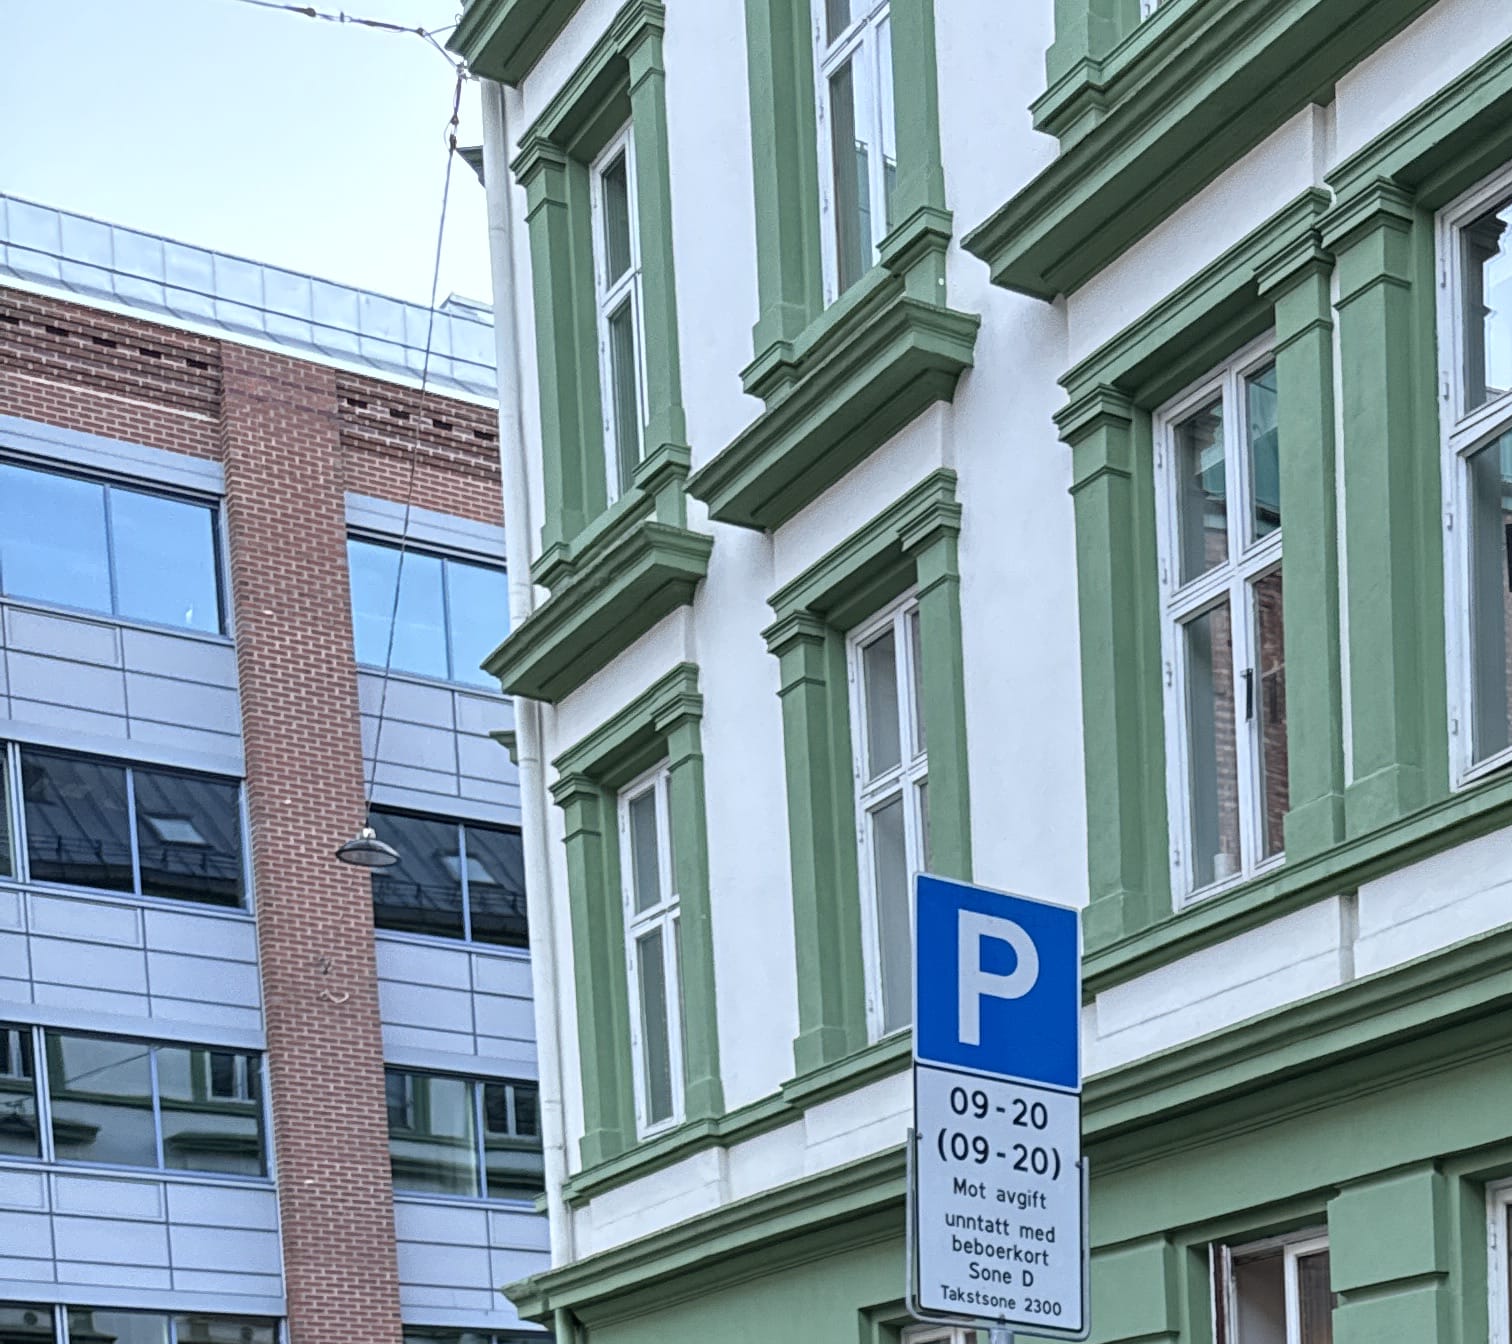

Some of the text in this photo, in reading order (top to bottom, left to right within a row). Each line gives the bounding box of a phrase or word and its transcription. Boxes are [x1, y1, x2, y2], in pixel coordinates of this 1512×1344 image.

[957, 908, 1040, 1047] P
[953, 1177, 1047, 1211] Mot avgift
[945, 1212, 1055, 1243] unntatt med
[952, 1235, 1049, 1266] beboerkort
[969, 1262, 1034, 1288] Sone D
[940, 1284, 1062, 1317] Takstsone 2300
